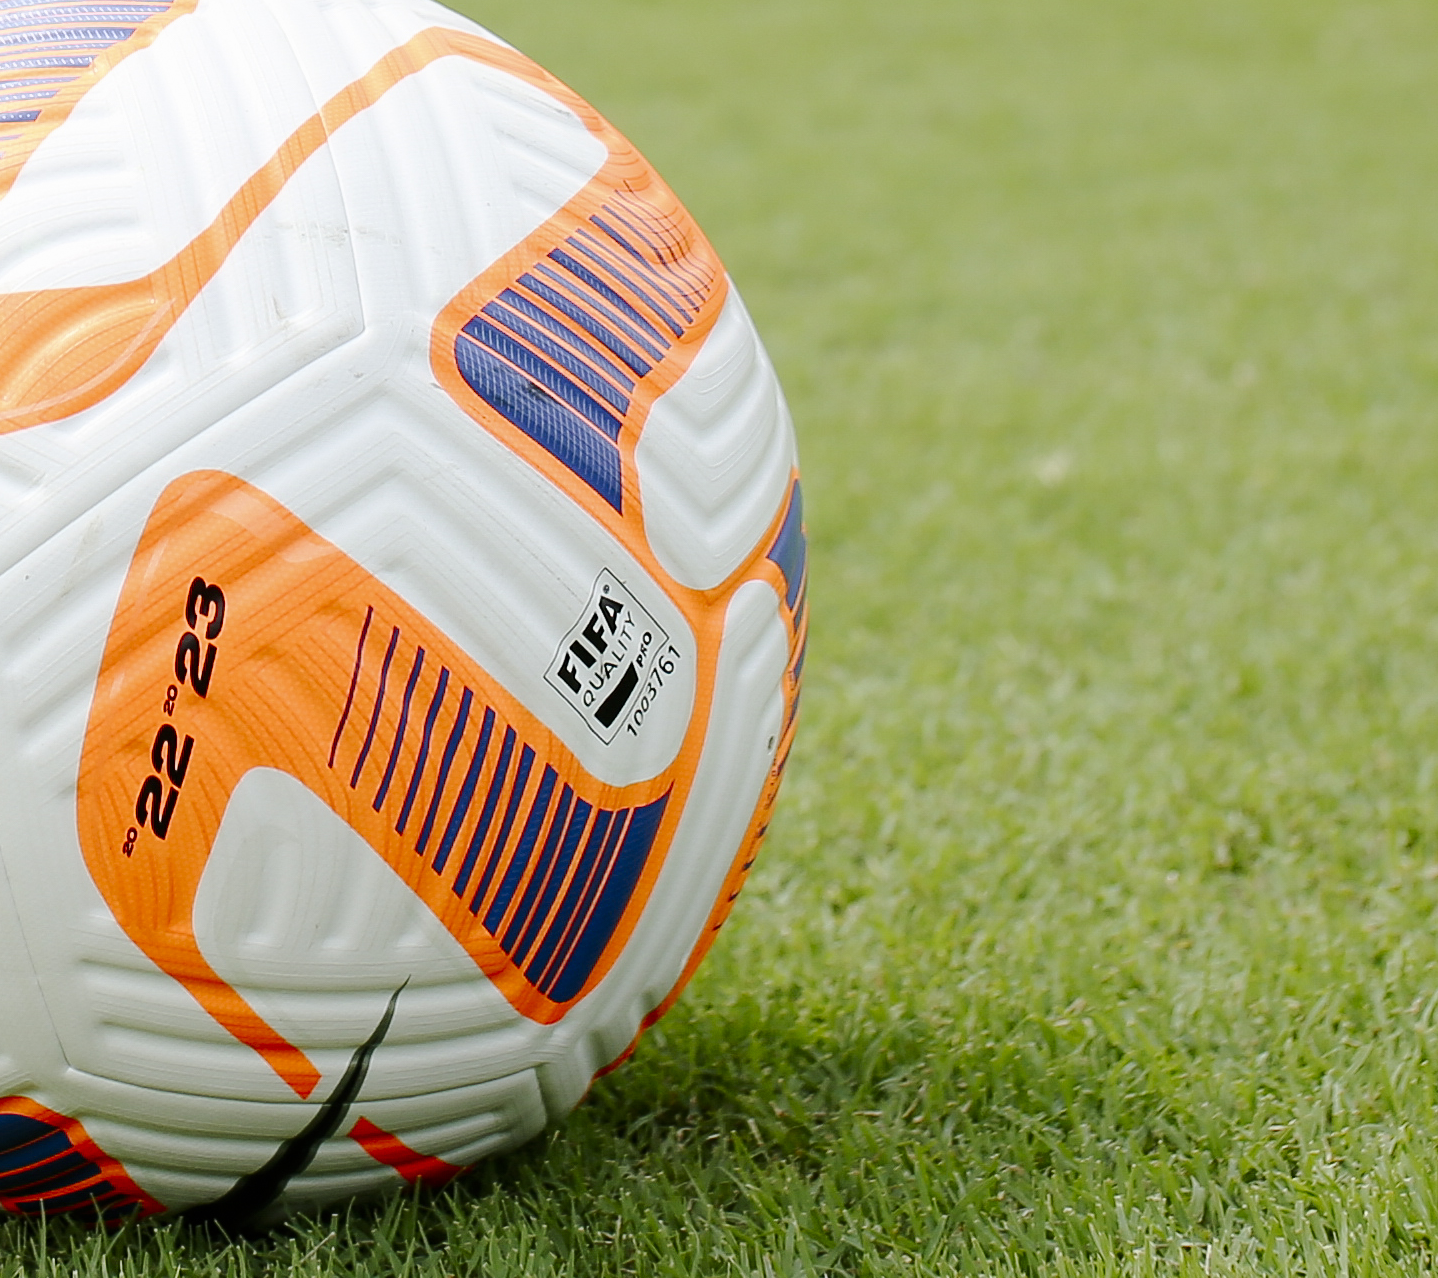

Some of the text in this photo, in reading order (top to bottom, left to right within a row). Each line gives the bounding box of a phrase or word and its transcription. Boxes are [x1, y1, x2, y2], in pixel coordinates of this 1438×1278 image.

[583, 611, 635, 707] QUALITY
[627, 645, 681, 736] 1003761
[635, 631, 652, 668] PRO
